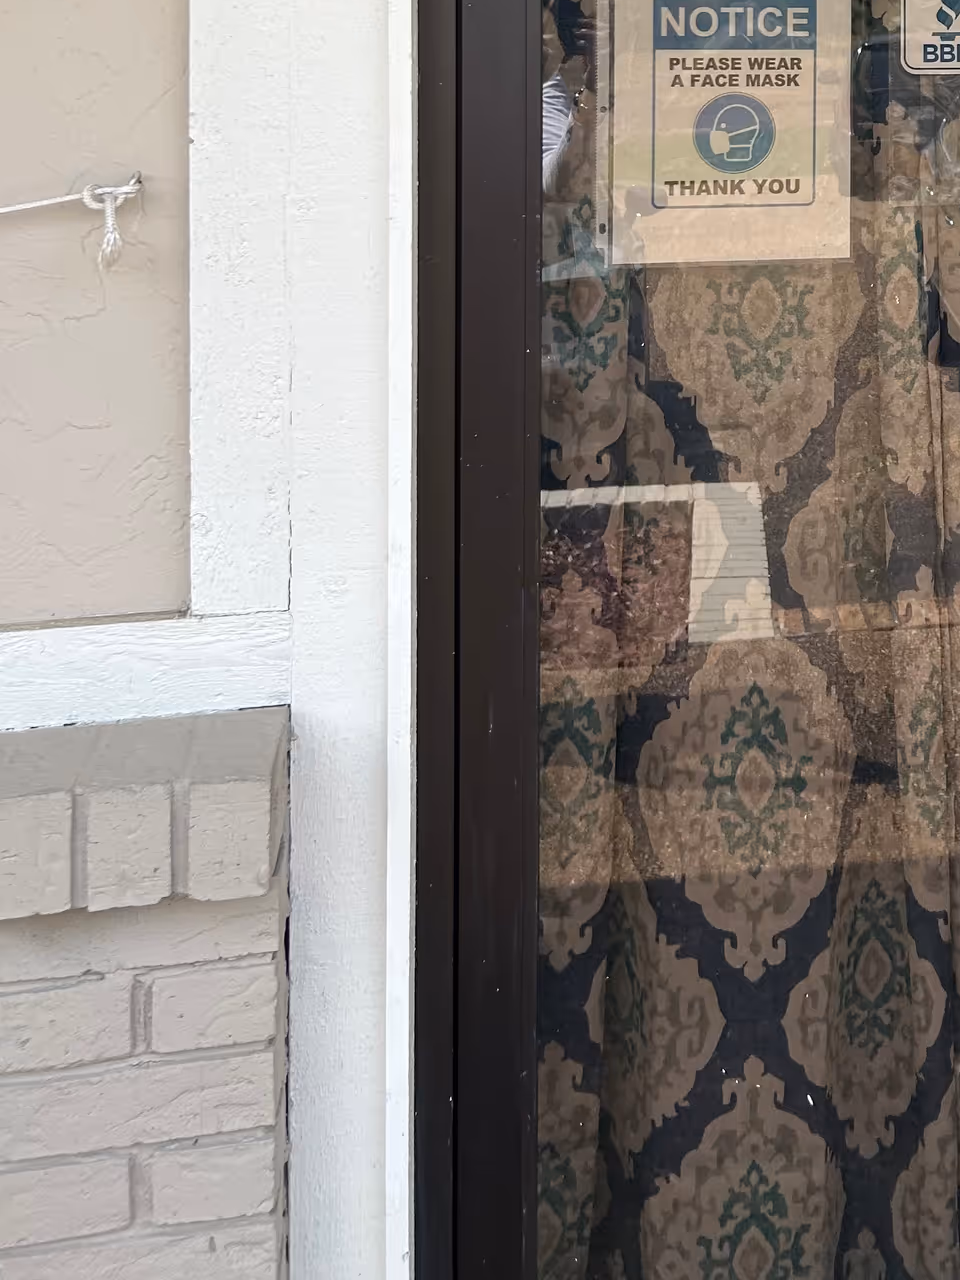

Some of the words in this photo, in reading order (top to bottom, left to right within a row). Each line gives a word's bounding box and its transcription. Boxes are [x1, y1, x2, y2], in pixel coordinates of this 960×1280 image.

[660, 6, 810, 38] NOTICE
[669, 57, 742, 71] PLEASE
[747, 57, 803, 71] WEAR
[670, 74, 684, 87] A
[690, 74, 740, 87] FACE
[745, 73, 800, 87] MASK
[664, 178, 746, 196] THANK
[751, 178, 800, 194] YOU
